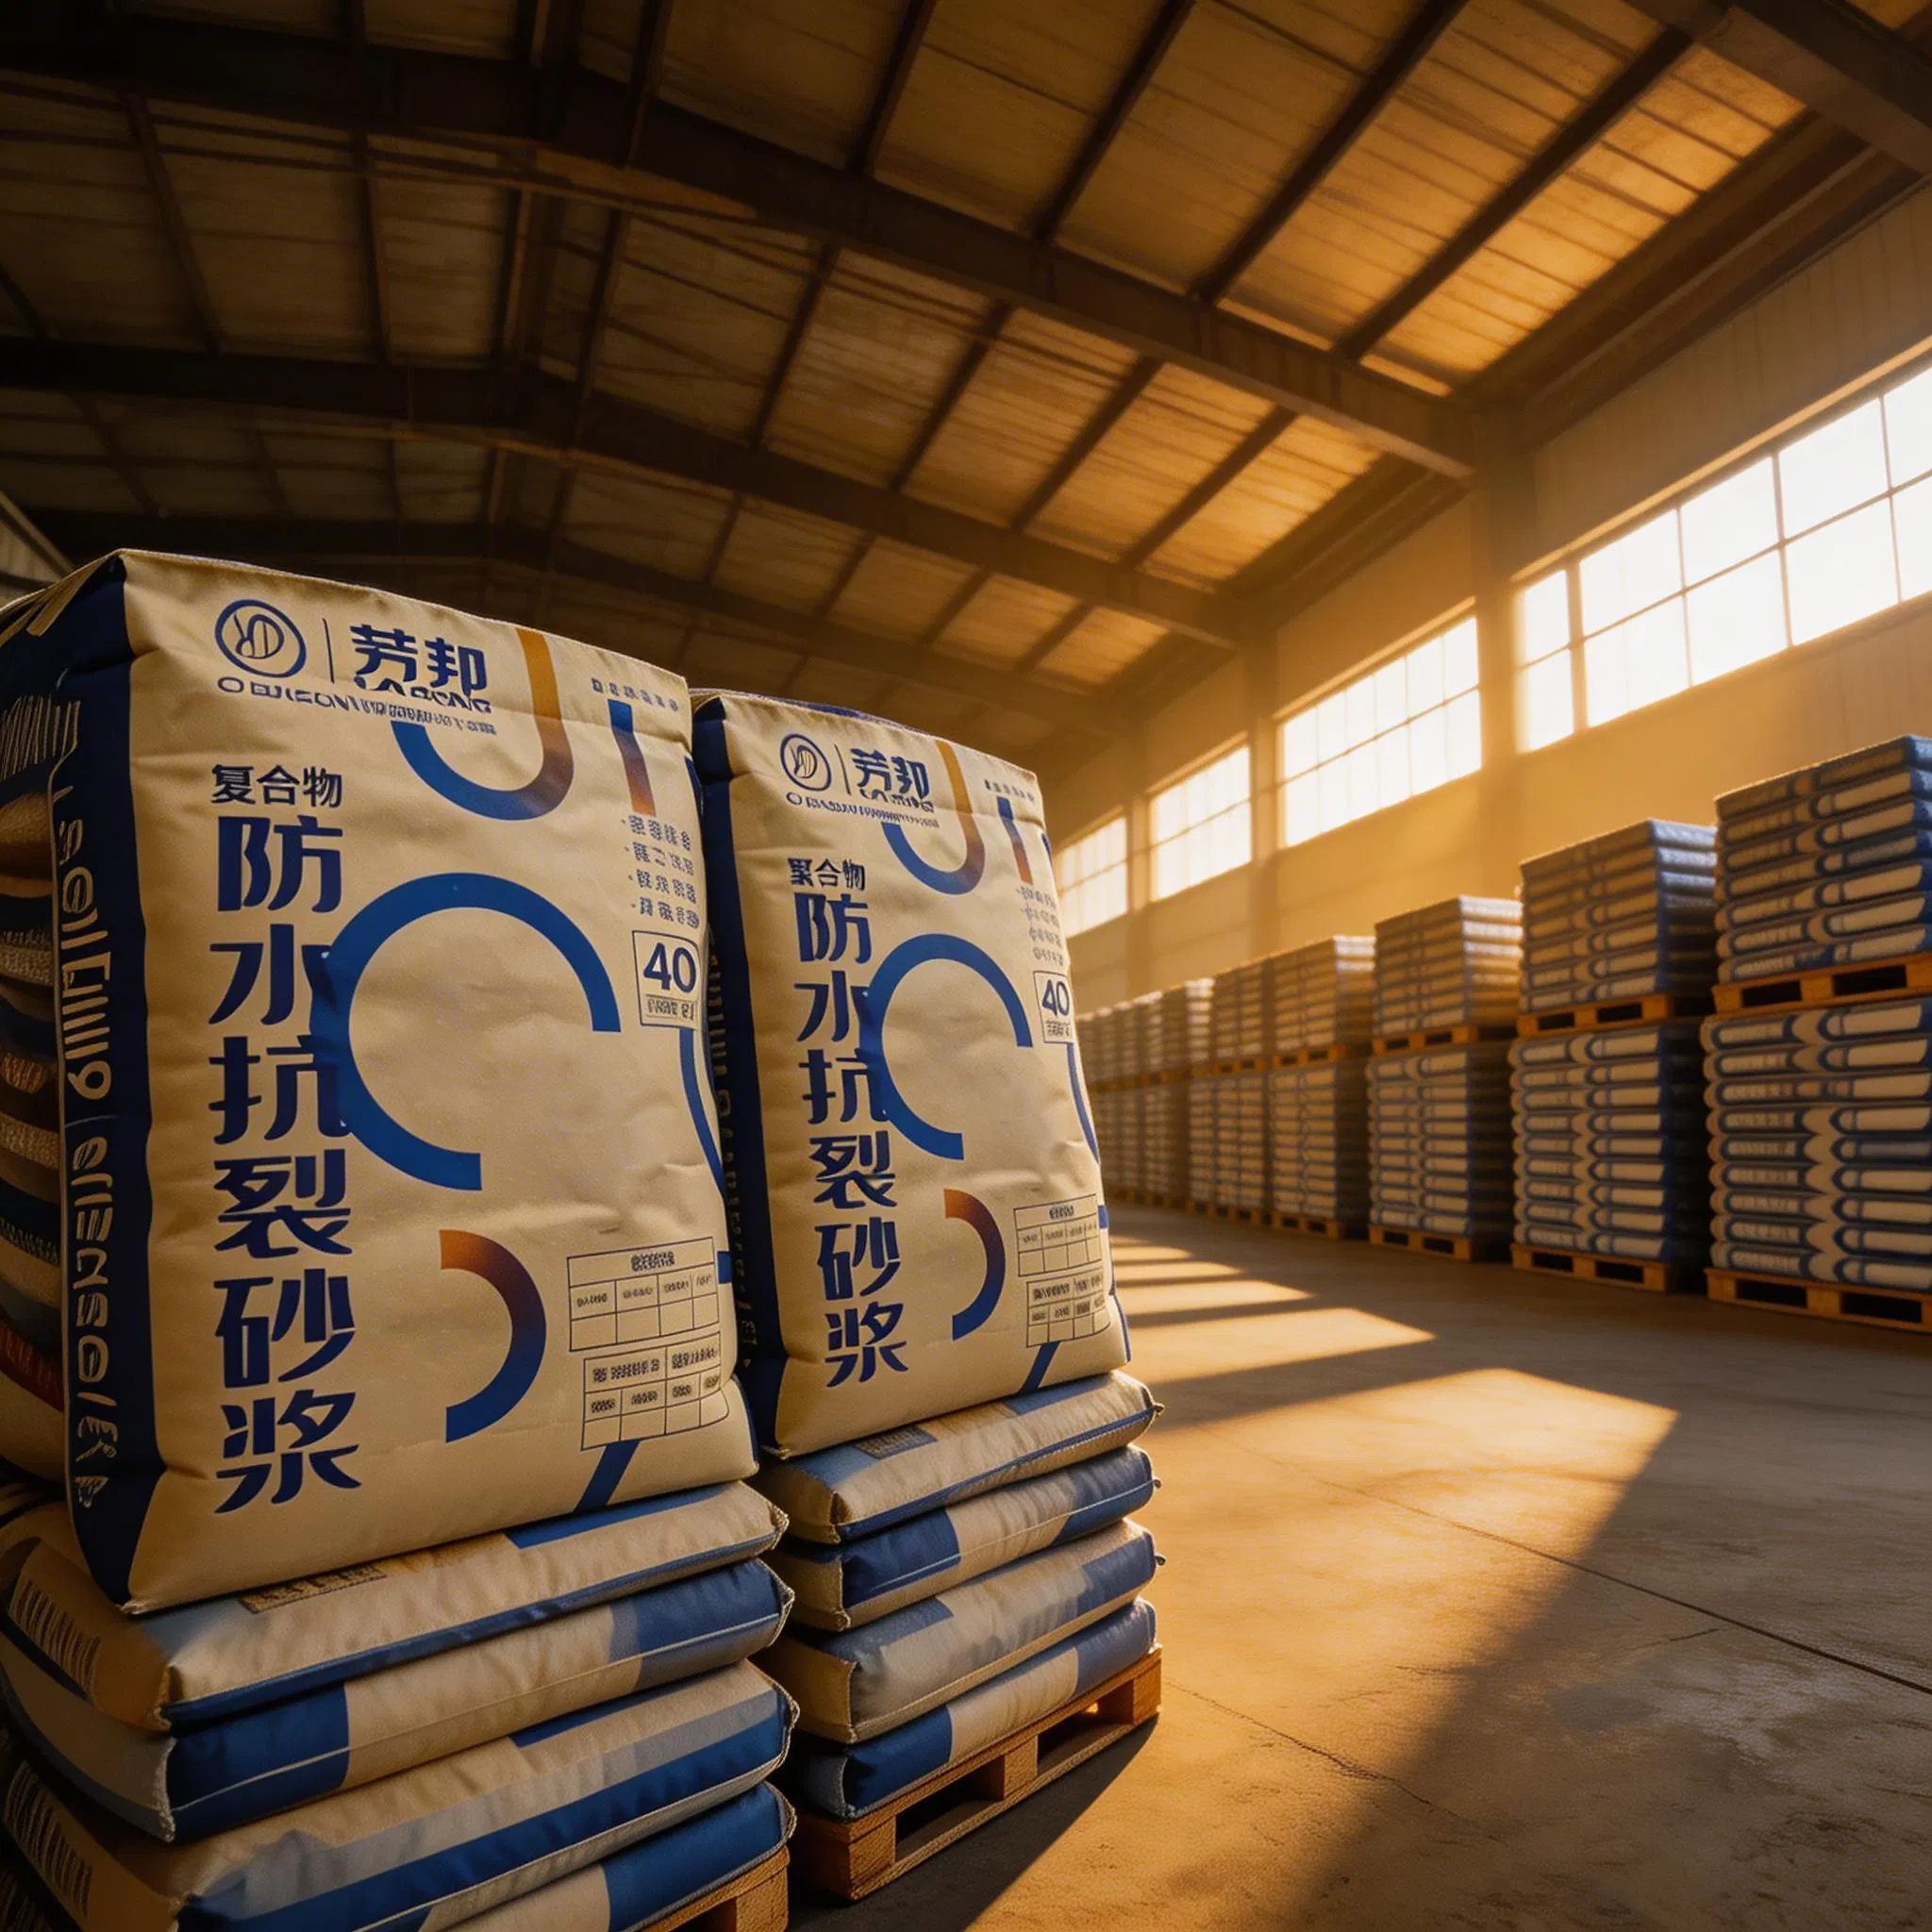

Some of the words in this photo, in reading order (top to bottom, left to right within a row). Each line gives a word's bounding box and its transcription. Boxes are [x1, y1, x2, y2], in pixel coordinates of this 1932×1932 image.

[210, 764, 342, 808] 复合物
[643, 941, 696, 993] 40
[1041, 978, 1071, 1016] 40
[208, 814, 361, 1514] 防水抗裂砂浆
[793, 892, 909, 1388] 防水抗裂砂浆
